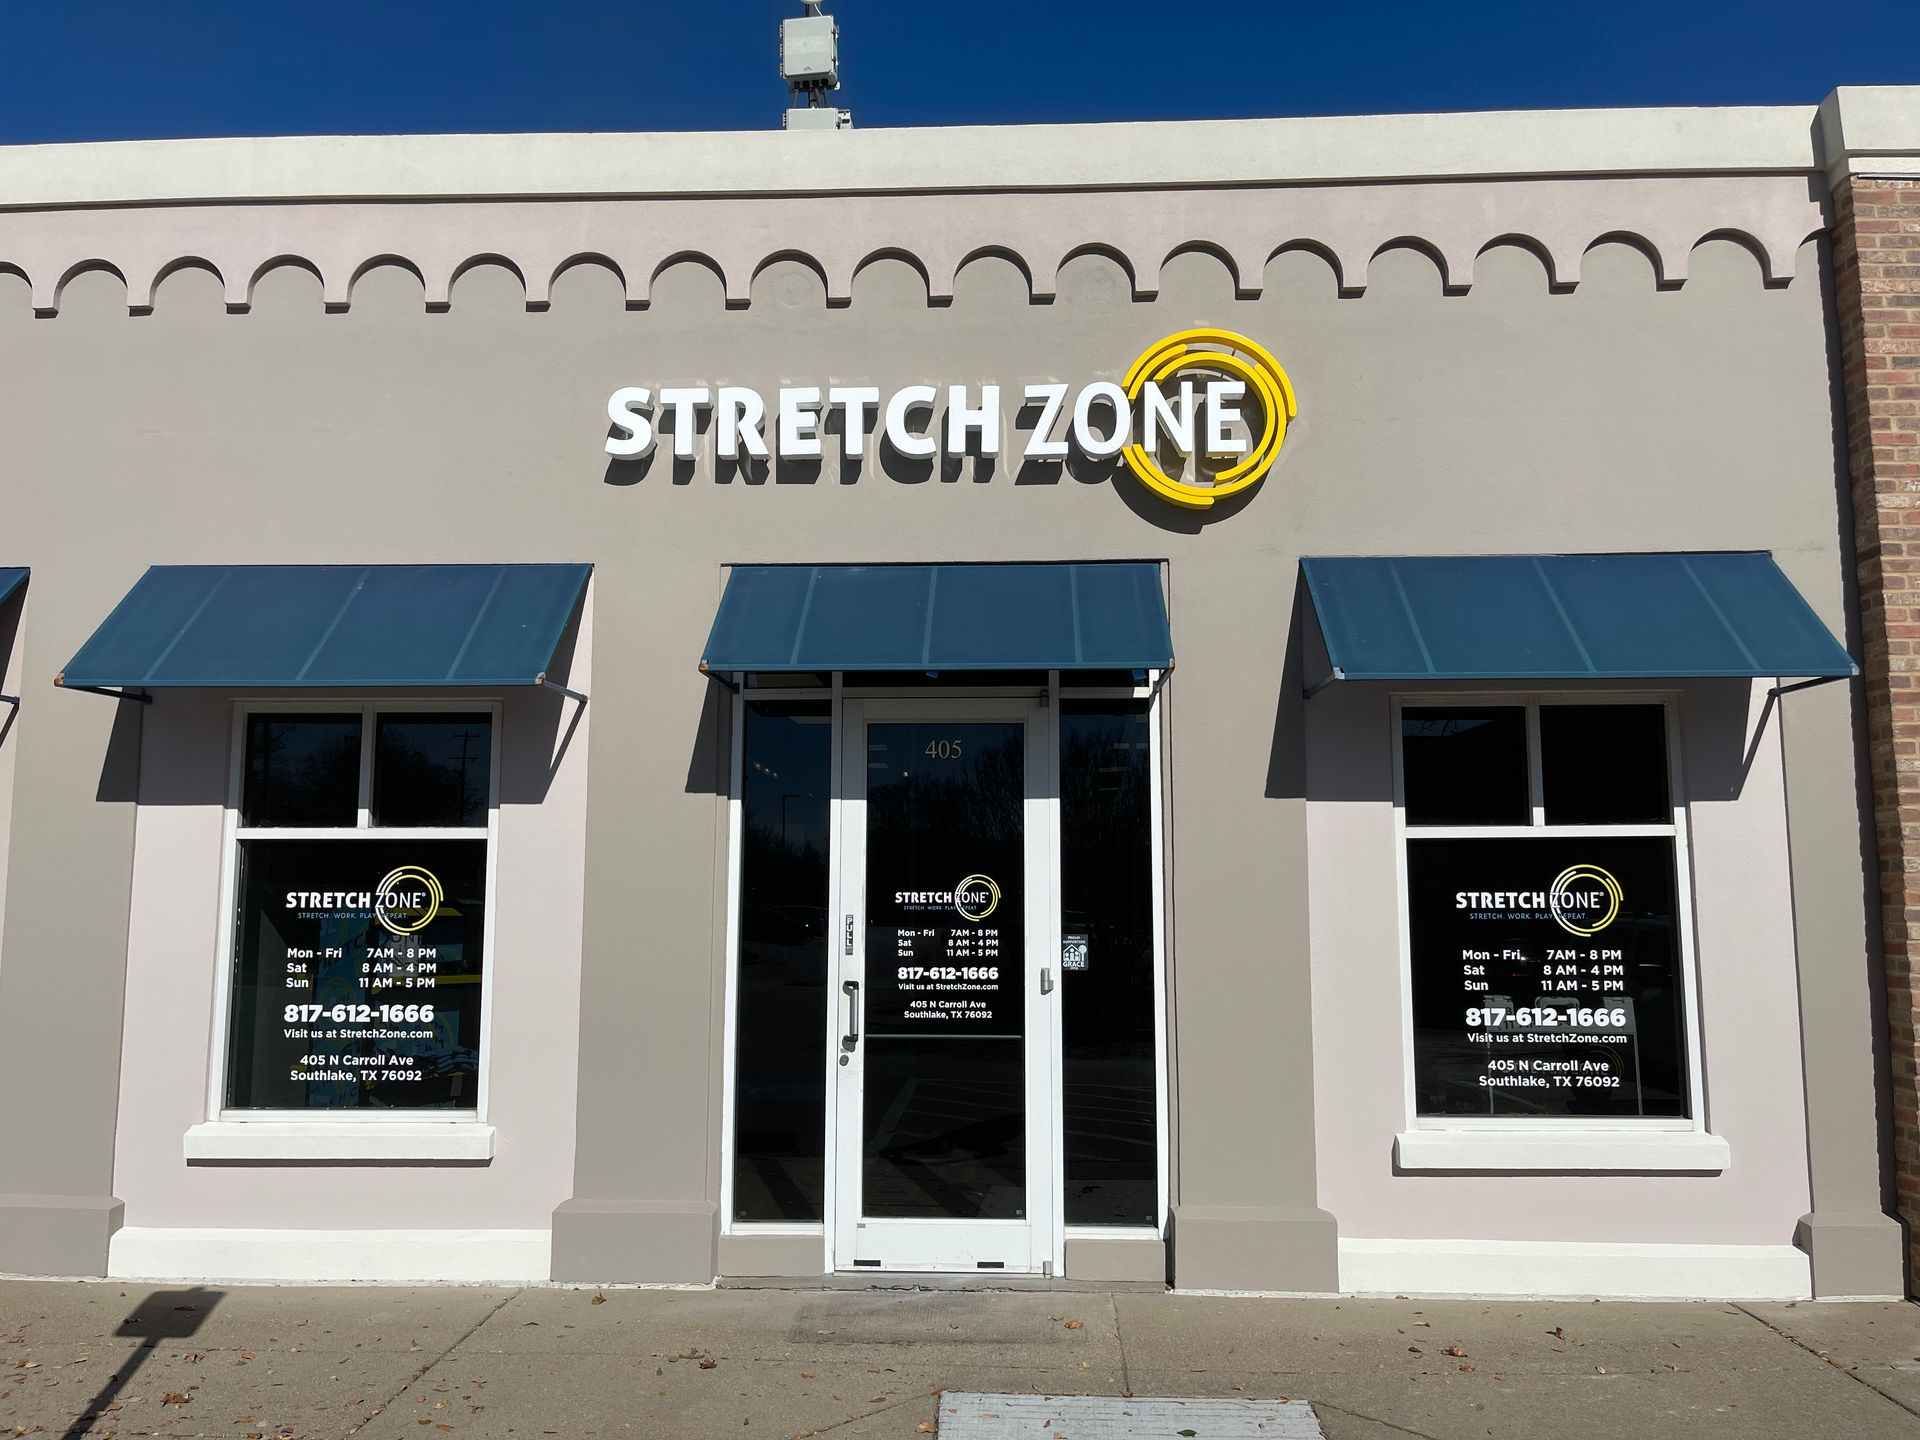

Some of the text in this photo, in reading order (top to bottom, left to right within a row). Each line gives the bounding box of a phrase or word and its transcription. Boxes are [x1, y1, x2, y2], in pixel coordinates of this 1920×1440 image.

[604, 381, 1247, 458] STRETCH ZONE
[925, 740, 962, 758] 405
[286, 892, 371, 909] STRETCH
[895, 892, 952, 904] STRETCH
[1455, 892, 1546, 909] STRETCH
[898, 929, 916, 937] Mon
[923, 929, 934, 937] Fri
[951, 929, 970, 937] 7AM
[978, 929, 984, 937] 8
[986, 929, 998, 937] PM
[898, 939, 912, 947] Sat
[948, 939, 954, 947] 8
[956, 939, 970, 947] AM
[978, 939, 984, 947] 4
[986, 939, 998, 947] PM
[287, 947, 314, 959] Mon
[326, 947, 342, 959] Fri
[367, 947, 394, 959] 7AM
[406, 947, 415, 959] 8
[418, 947, 437, 959] PM
[898, 949, 913, 957] Sun
[946, 949, 954, 957] 11
[956, 949, 970, 957] AM
[978, 949, 984, 957] 5
[985, 949, 998, 957] PM
[1462, 950, 1490, 960] Mon
[1546, 949, 1576, 960] 7AM
[1589, 949, 1598, 960] 8
[1602, 949, 1622, 960] PM
[287, 962, 307, 973] Sat
[361, 962, 370, 973] 8
[373, 962, 394, 974] AM
[406, 962, 415, 974] 4
[418, 962, 437, 974] PM
[898, 967, 999, 980] 817-612-1666
[1463, 965, 1485, 976] Sat
[1543, 965, 1552, 976] 8
[1555, 965, 1577, 976] AM
[1590, 965, 1600, 976] 4
[1604, 965, 1624, 976] PM
[286, 977, 309, 988] Sun
[359, 977, 369, 988] 11
[373, 977, 393, 988] AM
[405, 977, 413, 988] 5
[417, 977, 436, 988] PM
[1464, 980, 1489, 991] Sun
[1541, 980, 1552, 991] 11
[1556, 980, 1578, 991] AM
[1591, 980, 1600, 991] 5
[1604, 980, 1624, 991] PM
[910, 1001, 986, 1009] 405 N Carroll Ave
[284, 1004, 434, 1023] 817-612-1666
[904, 1011, 992, 1020] Southlake, TX 76092
[1465, 1008, 1626, 1027] 817-612-1666
[284, 1029, 433, 1039] Visit us at StretchZone.com
[1467, 1033, 1627, 1044] Visit us at StretchZone.com
[300, 1054, 414, 1066] 405 N Carroll Ave
[1488, 1060, 1515, 1071] 405
[1519, 1060, 1529, 1071] N
[1533, 1060, 1579, 1071] Carroll
[1582, 1060, 1609, 1072] Ave
[290, 1070, 422, 1083] Southlake, TX 76092
[1479, 1075, 1620, 1089] Southlake, TX 76092
